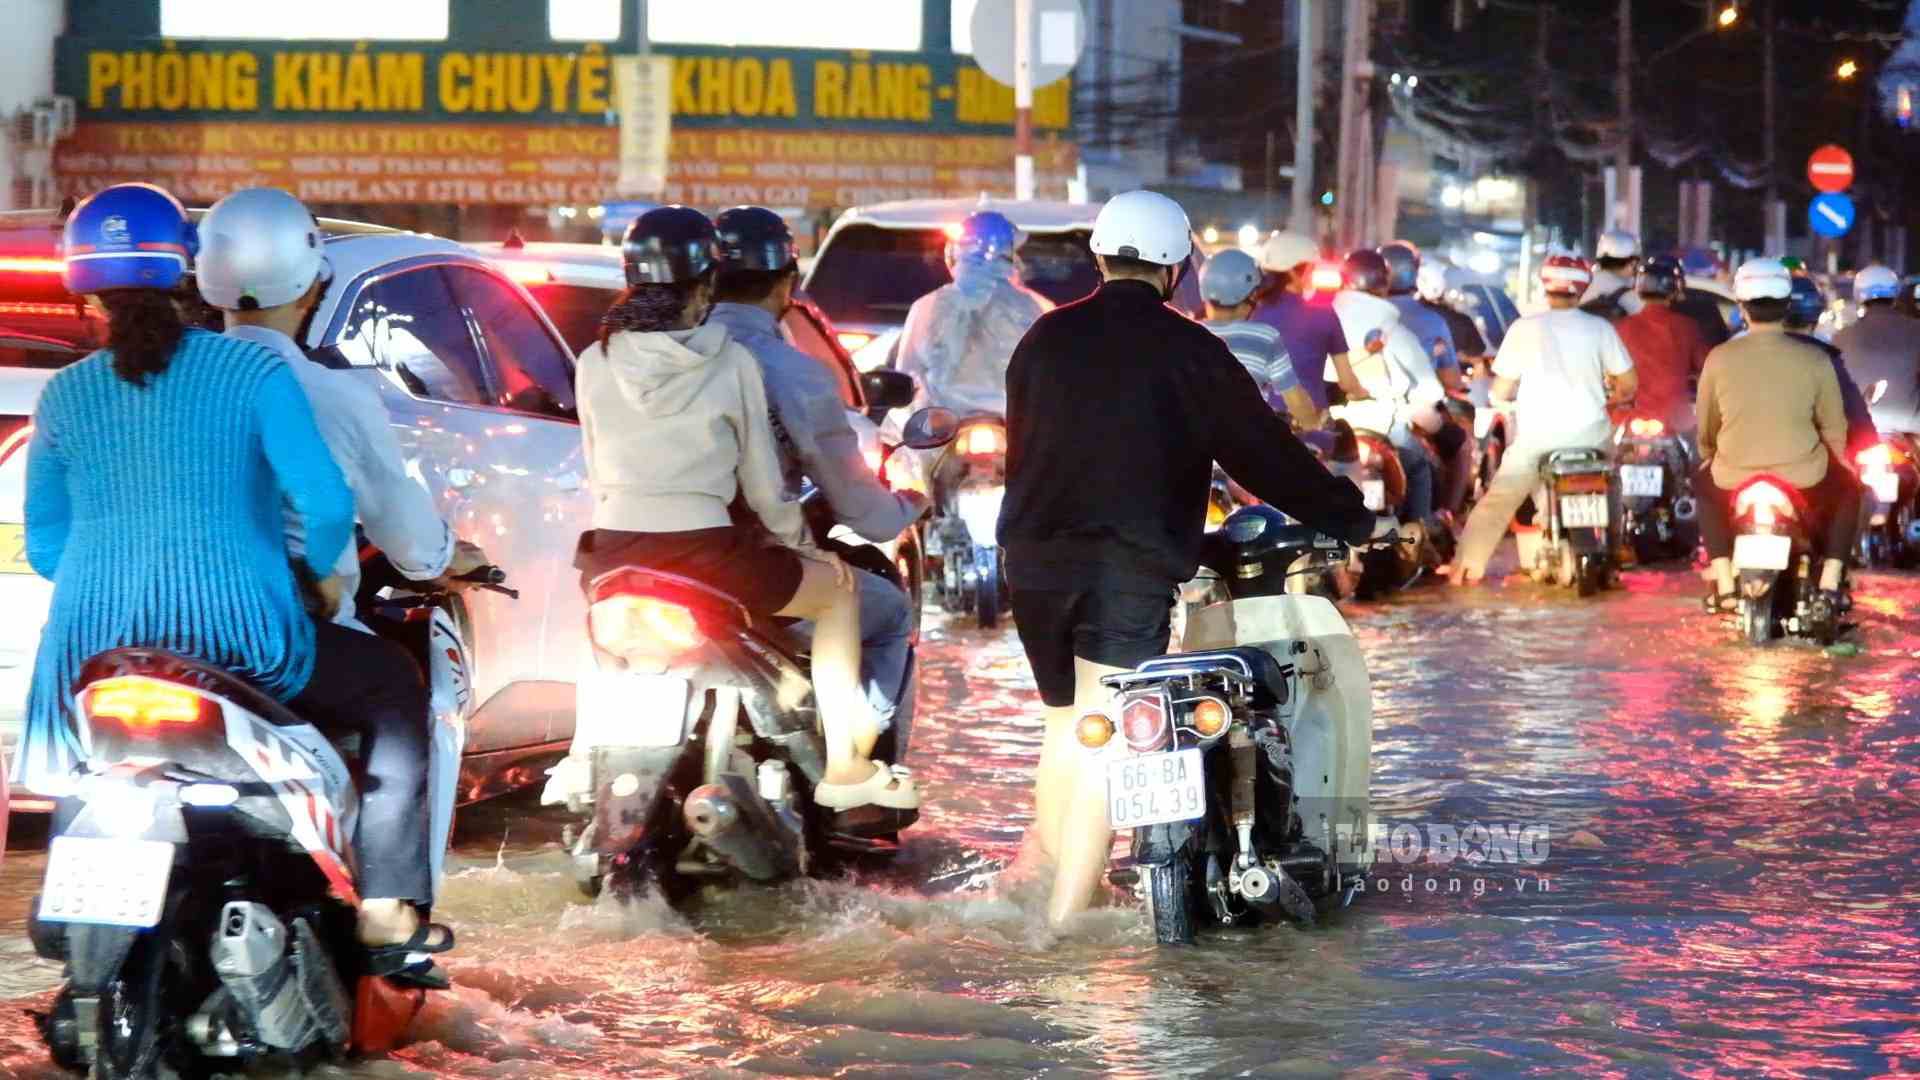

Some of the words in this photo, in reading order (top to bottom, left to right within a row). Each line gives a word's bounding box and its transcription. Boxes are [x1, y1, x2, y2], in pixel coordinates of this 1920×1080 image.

[273, 40, 424, 112] KHÁM
[438, 42, 613, 113] CHUYÊ
[671, 56, 797, 119] KHOA
